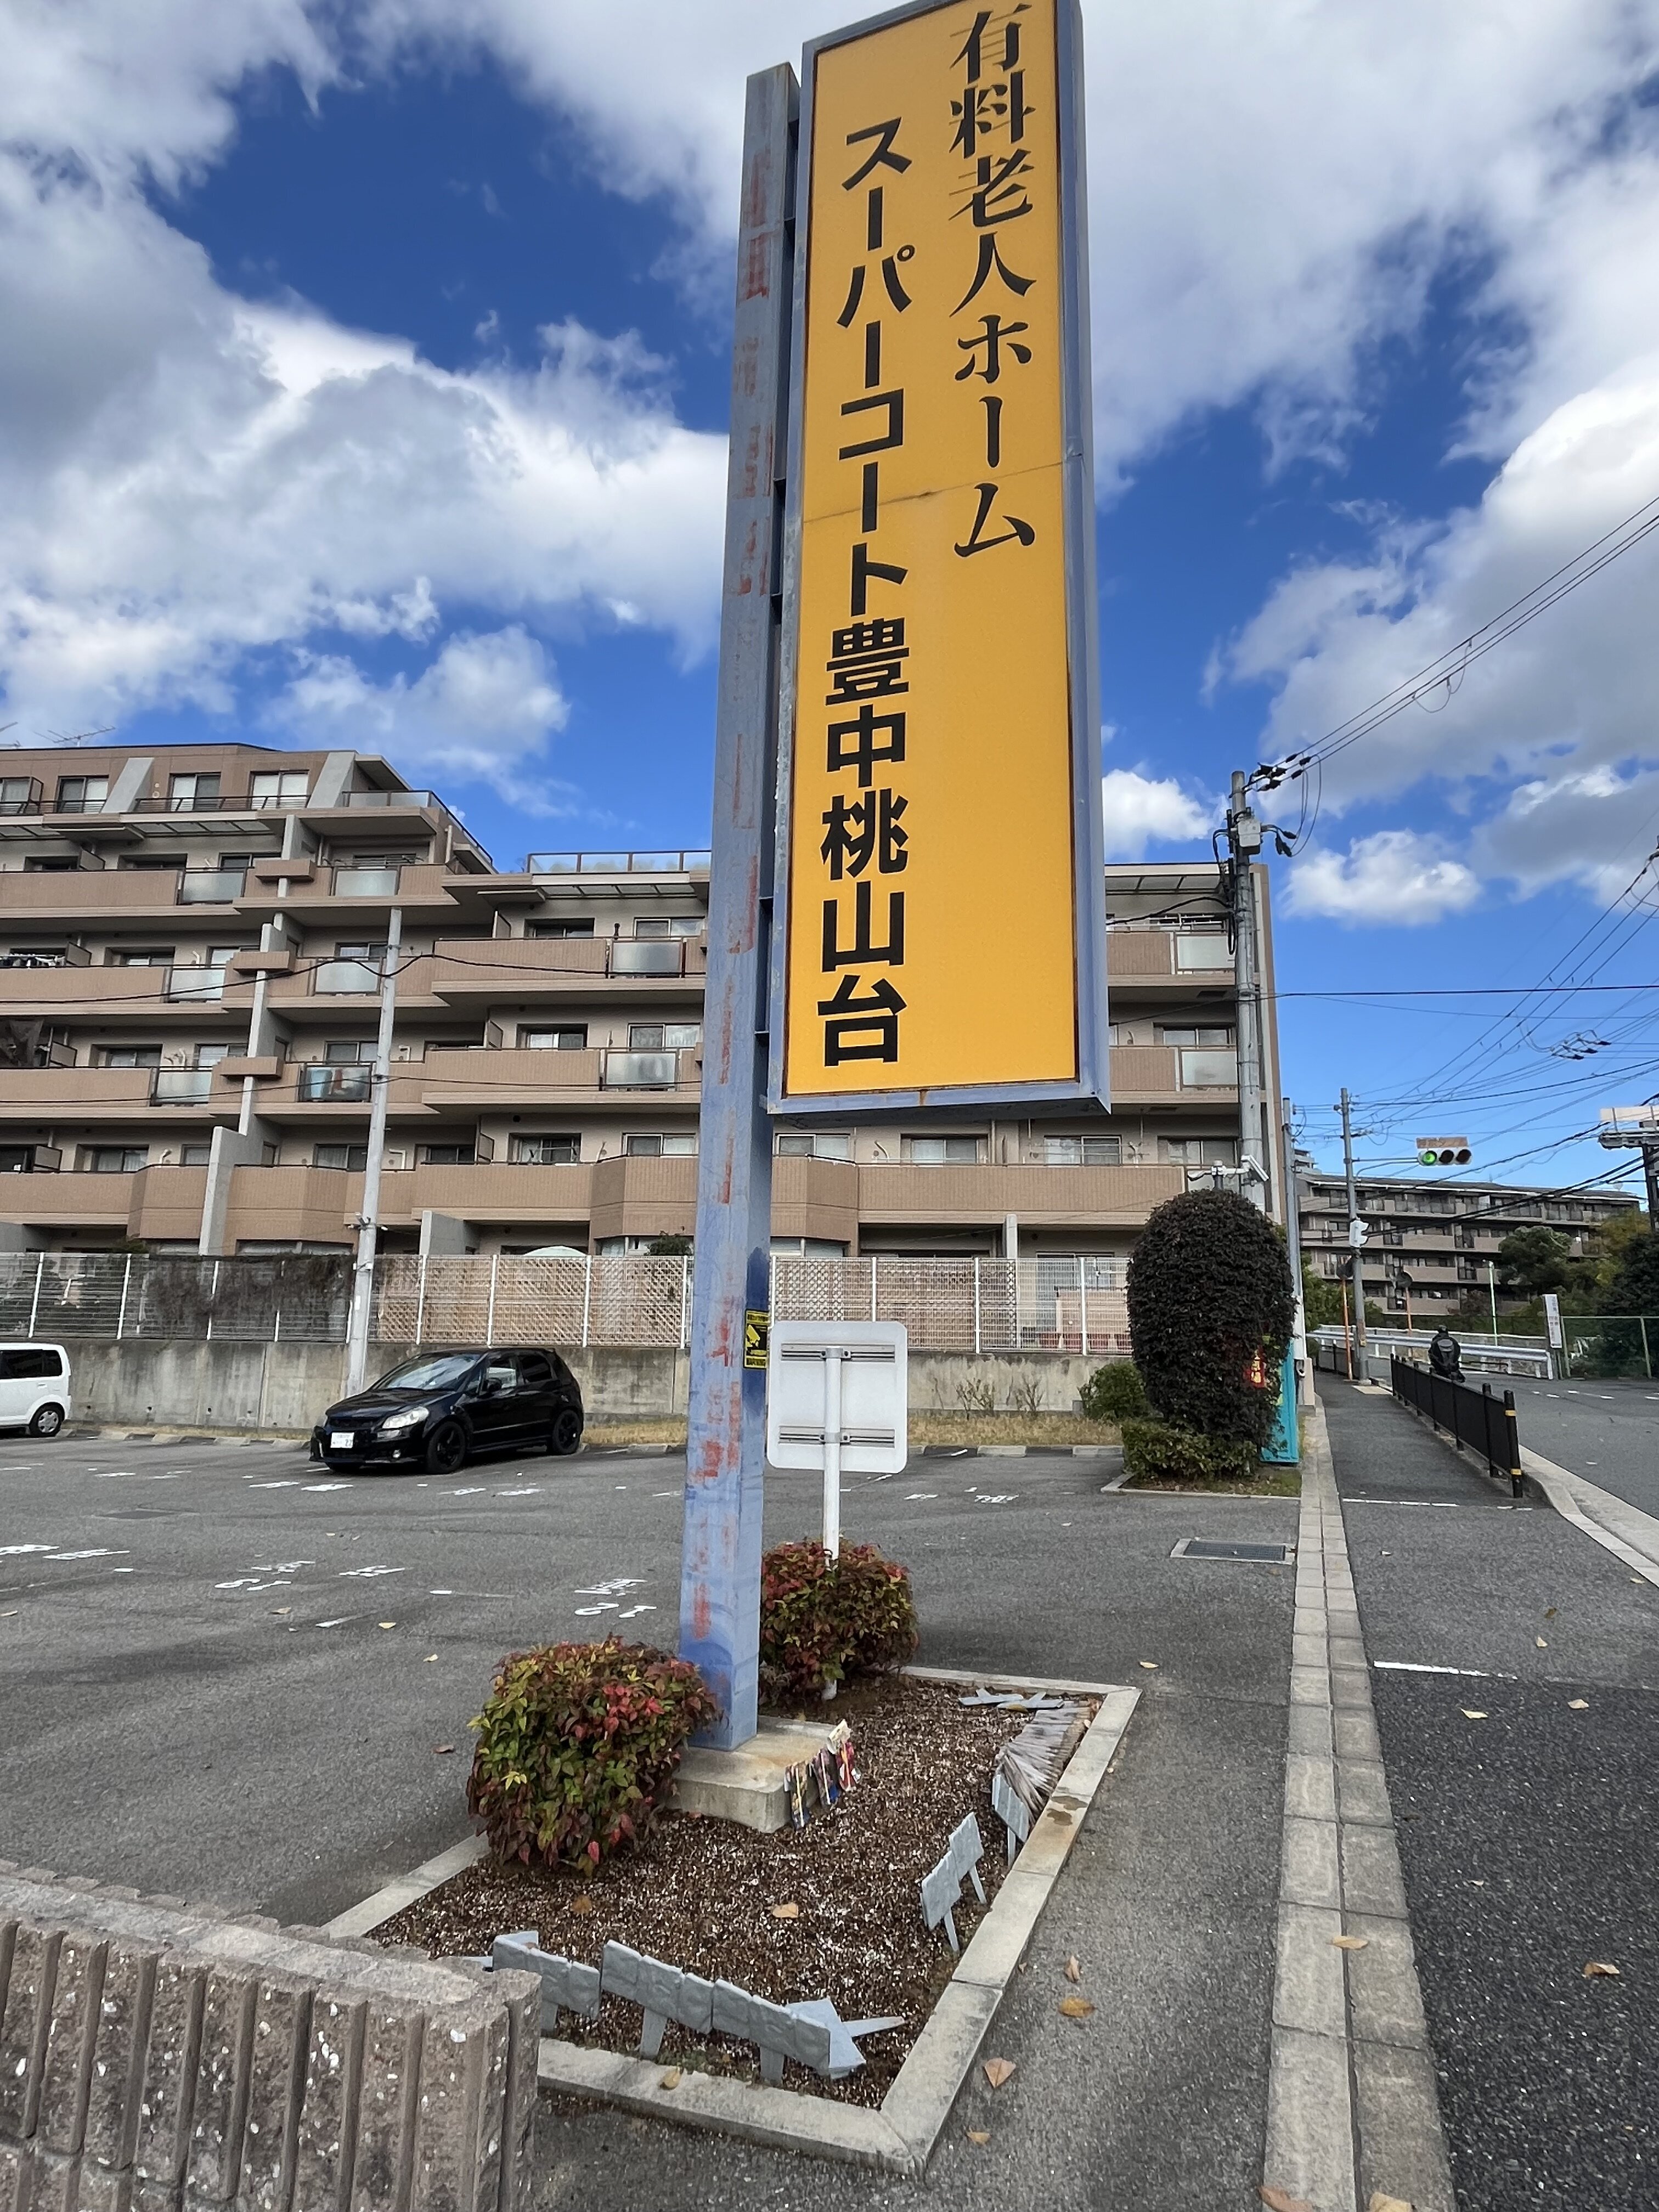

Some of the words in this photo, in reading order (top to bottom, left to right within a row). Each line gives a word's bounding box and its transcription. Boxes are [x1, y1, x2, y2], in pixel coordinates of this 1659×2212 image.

[817, 116, 916, 1067] スーパーコート豊中桃山台
[950, 3, 1036, 558] 有料老人ホーム
